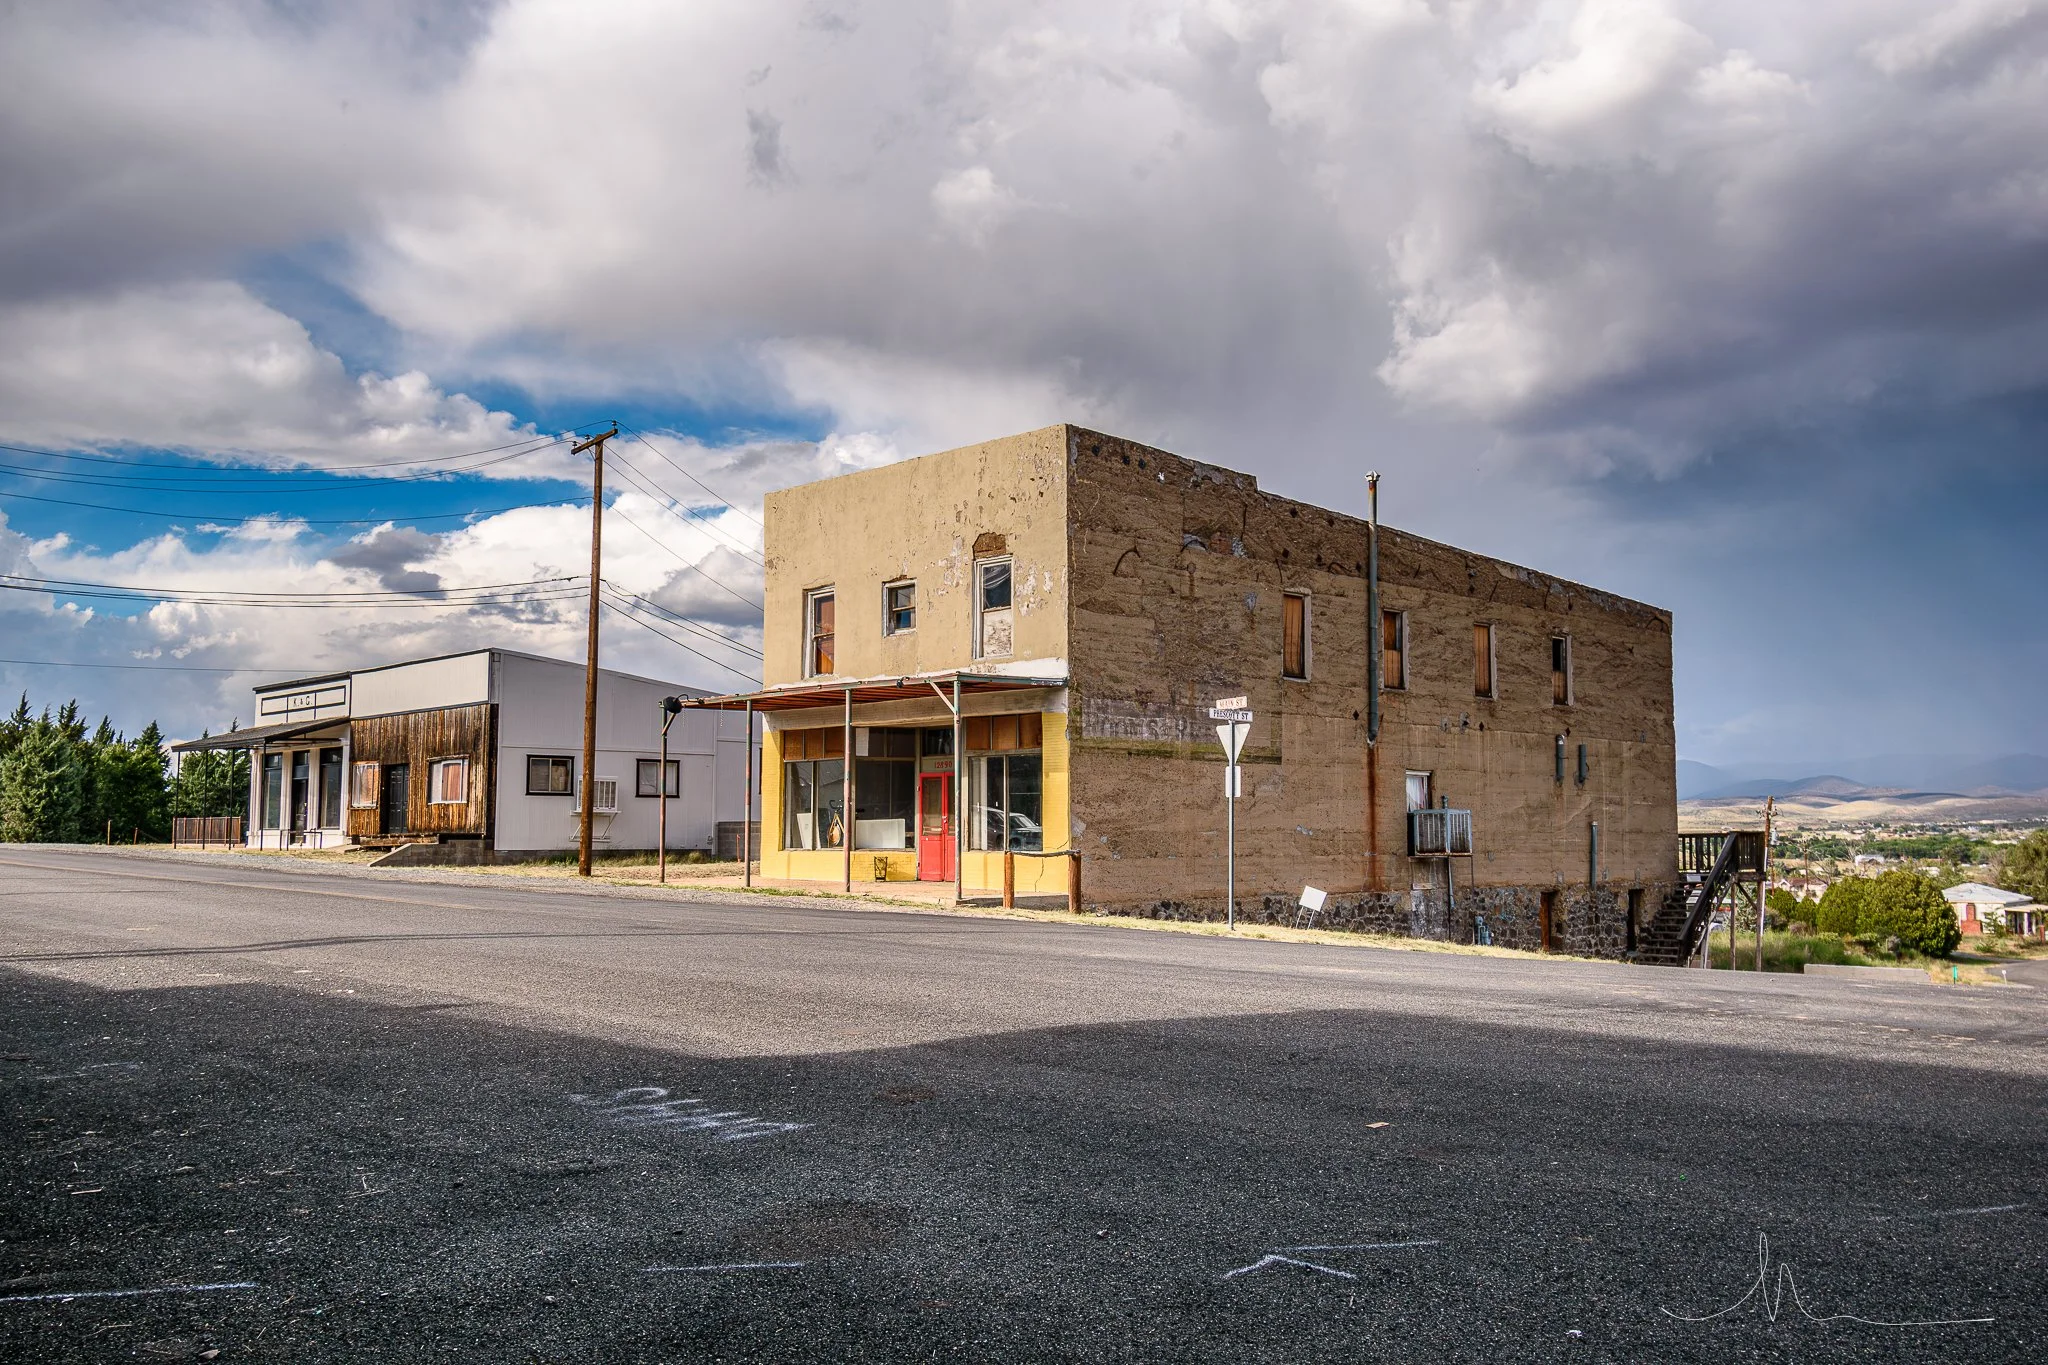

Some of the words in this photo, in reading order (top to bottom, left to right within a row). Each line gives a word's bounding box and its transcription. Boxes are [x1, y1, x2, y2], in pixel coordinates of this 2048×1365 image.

[1219, 700, 1234, 708] MAIN
[1236, 698, 1244, 706] ST
[1213, 710, 1239, 720] PRESCOTT
